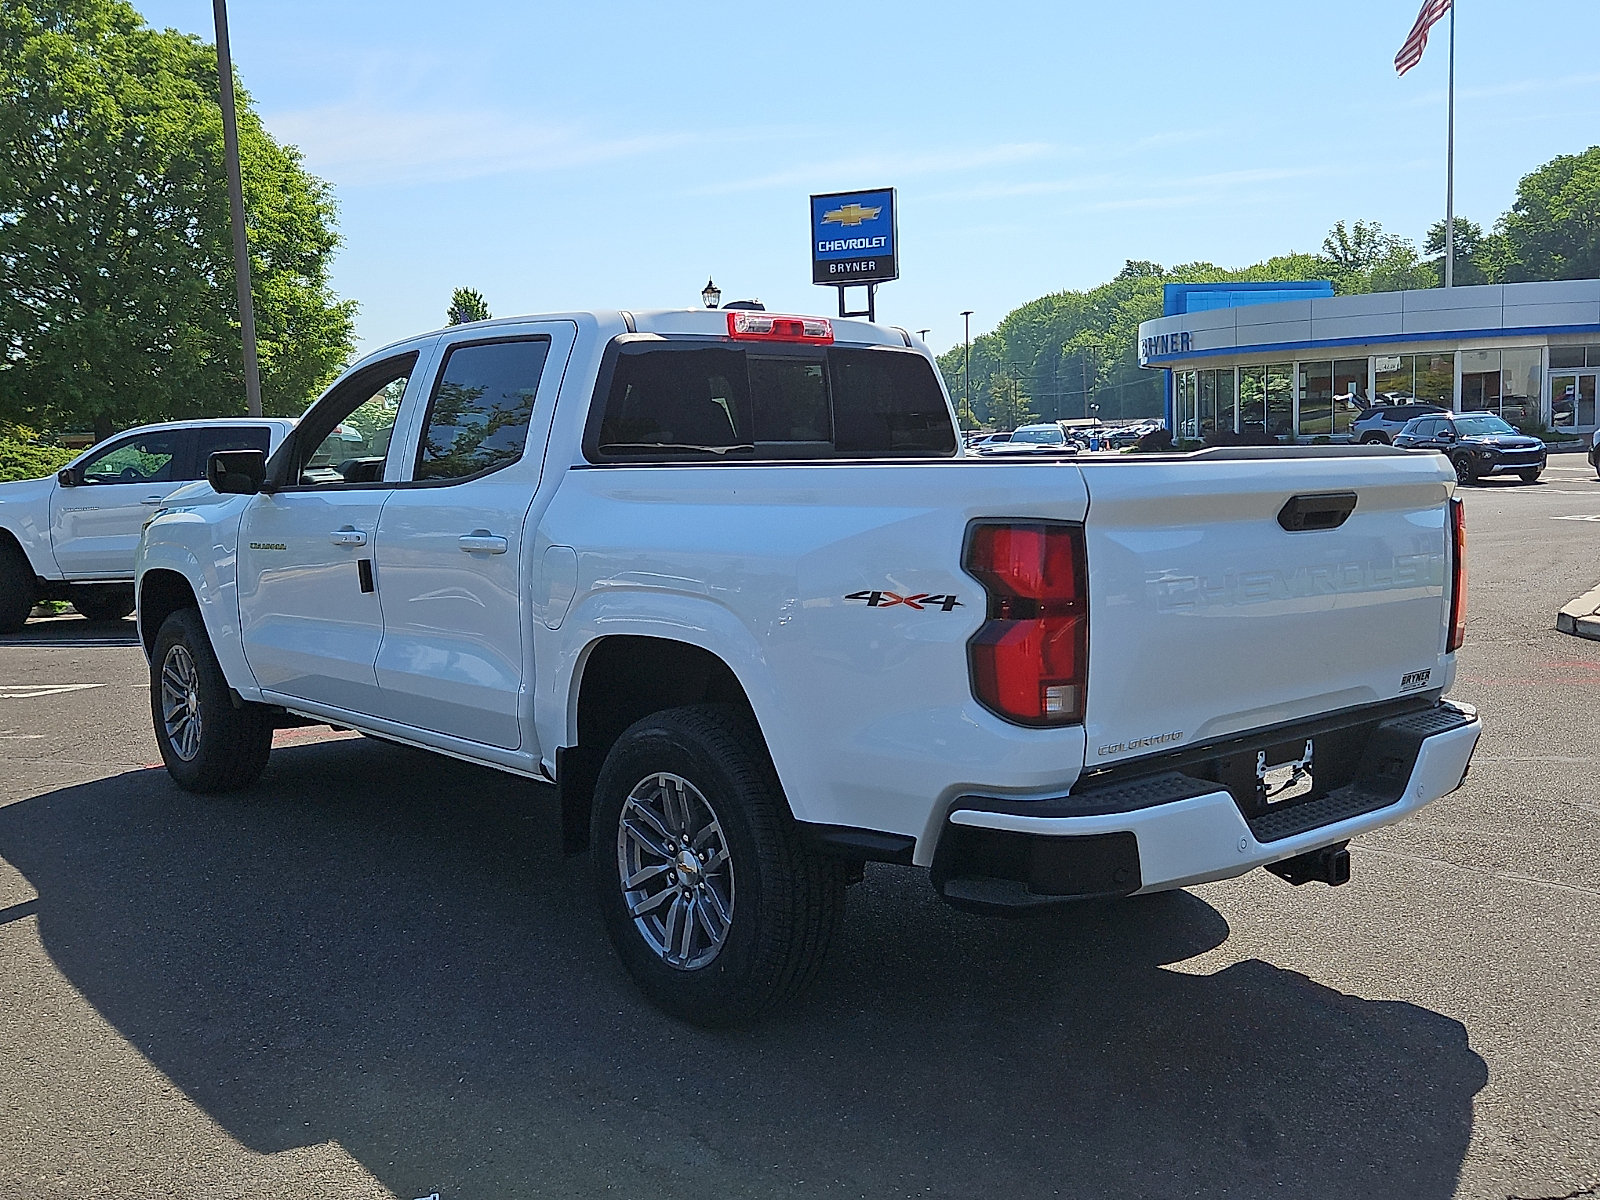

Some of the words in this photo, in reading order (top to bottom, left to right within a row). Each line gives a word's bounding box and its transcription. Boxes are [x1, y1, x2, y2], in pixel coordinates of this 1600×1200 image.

[818, 236, 887, 252] CHEVROLET
[829, 260, 876, 274] BRYNER
[1140, 331, 1191, 357] BRYNER
[1400, 670, 1431, 686] BRYNER
[1098, 730, 1184, 756] COLORADO
